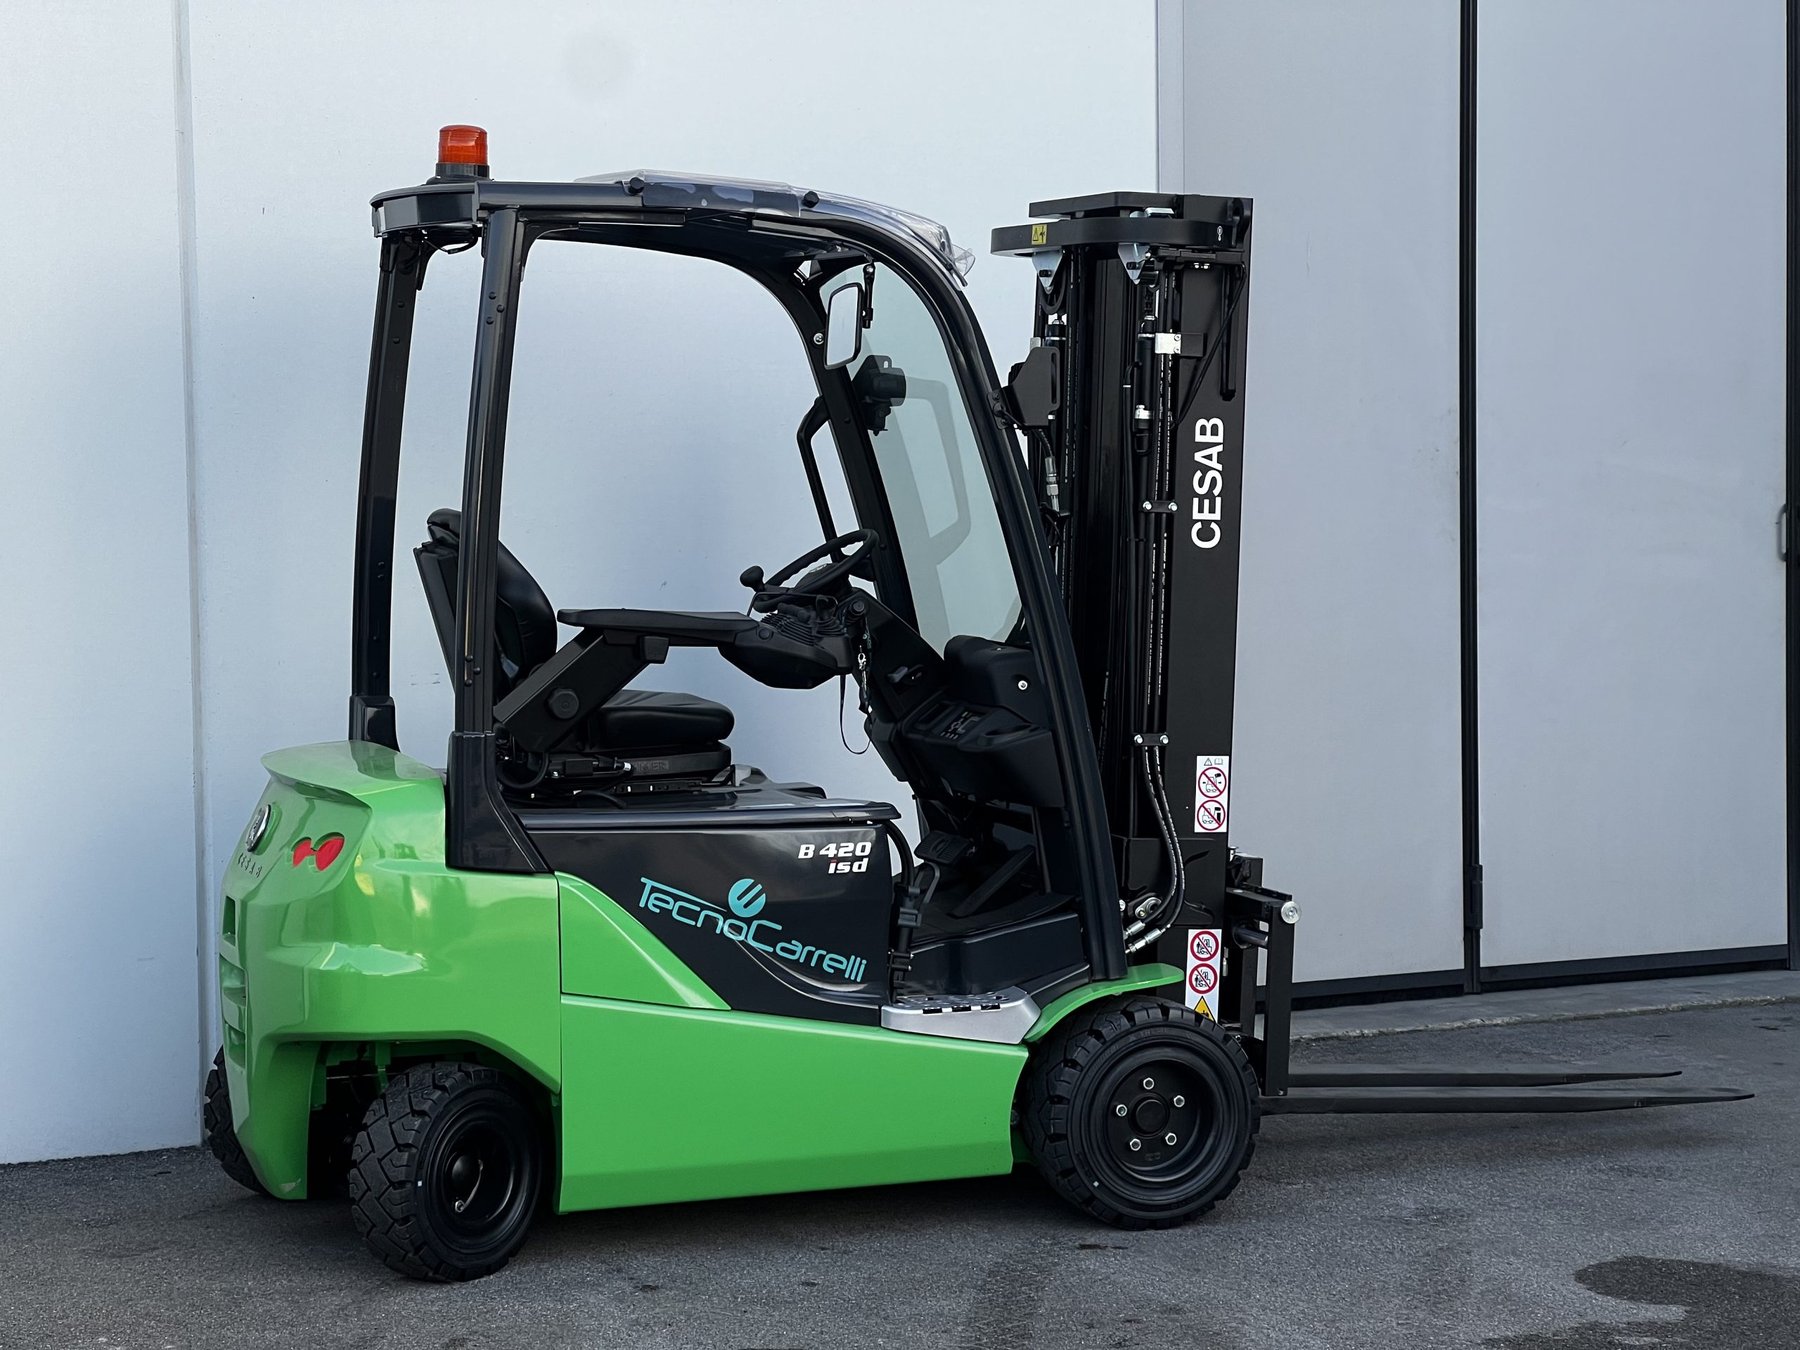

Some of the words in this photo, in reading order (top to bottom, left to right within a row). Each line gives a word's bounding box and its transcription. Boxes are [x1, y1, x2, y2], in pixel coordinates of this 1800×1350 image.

[1191, 417, 1224, 549] CESAB
[798, 844, 815, 859] B
[819, 842, 872, 859] 420
[828, 858, 868, 875] isd
[638, 876, 868, 983] TecnoCarrelli
